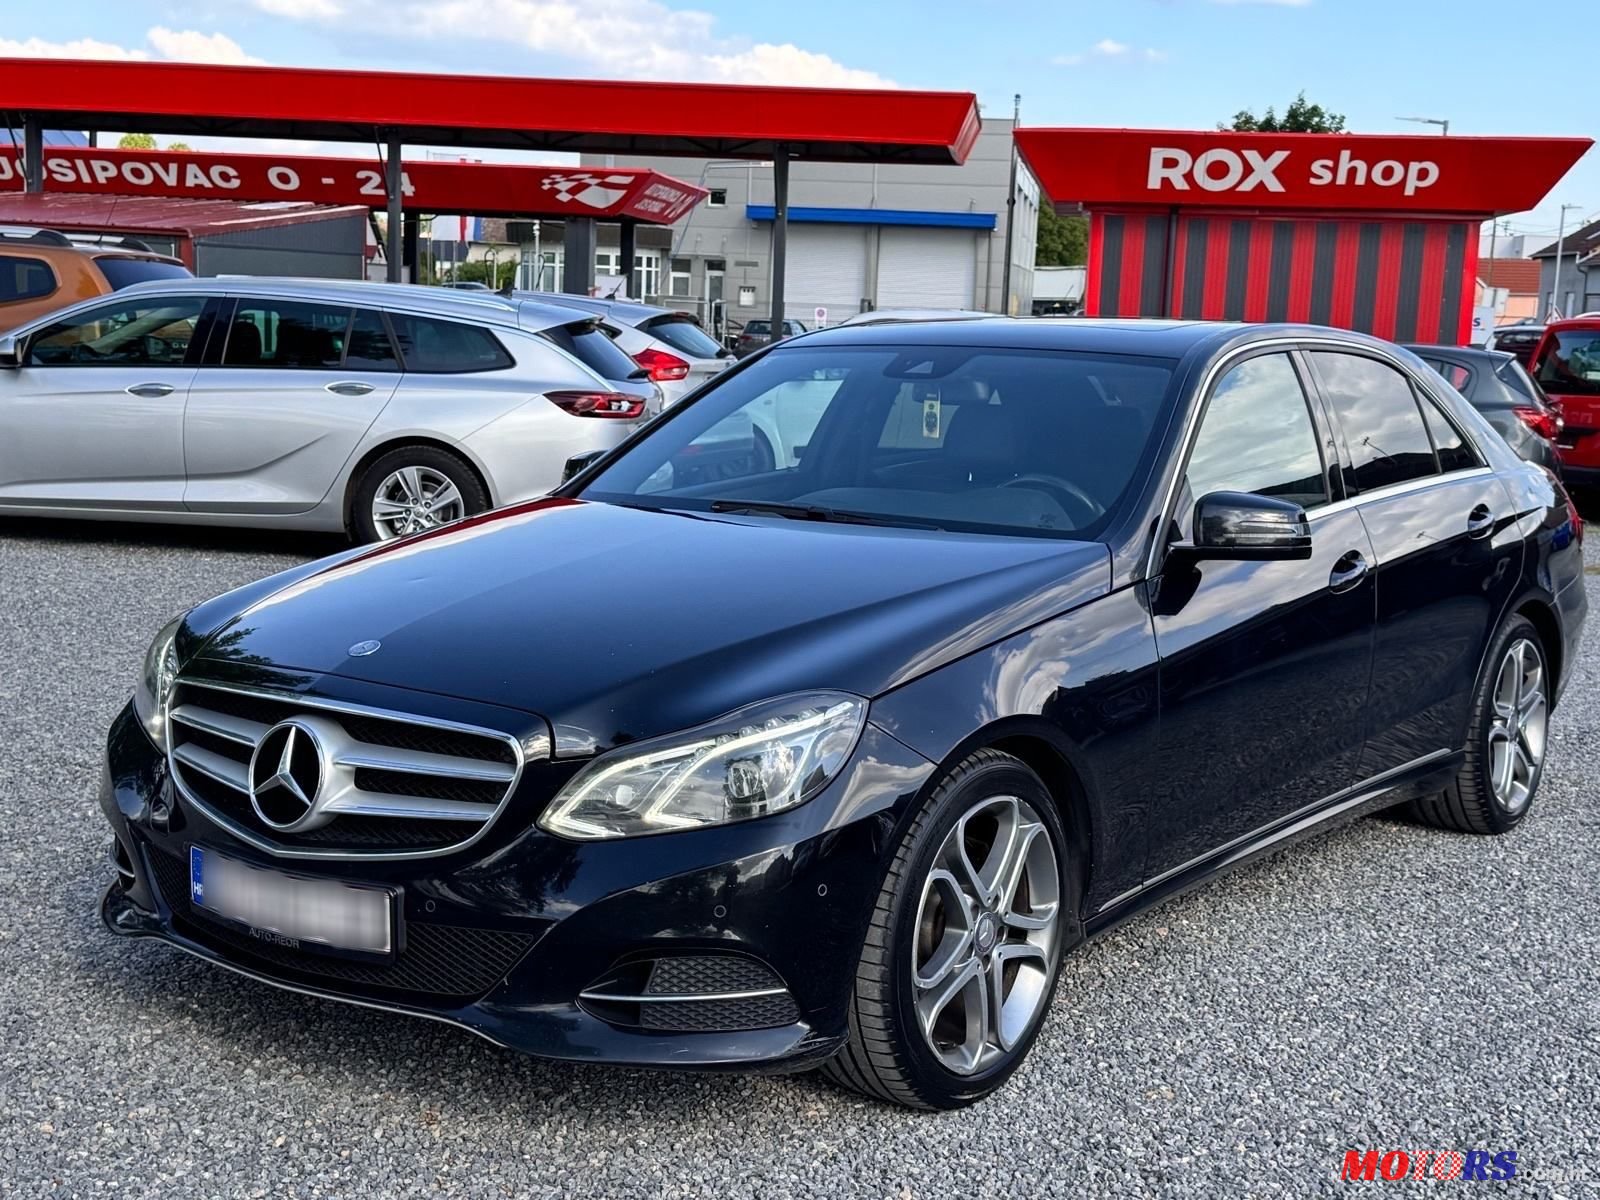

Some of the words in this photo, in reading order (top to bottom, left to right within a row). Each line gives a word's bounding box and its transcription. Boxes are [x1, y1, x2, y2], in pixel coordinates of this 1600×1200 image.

[356, 170, 416, 197] 24
[1147, 147, 1292, 192] ROX
[1309, 150, 1440, 196] shop
